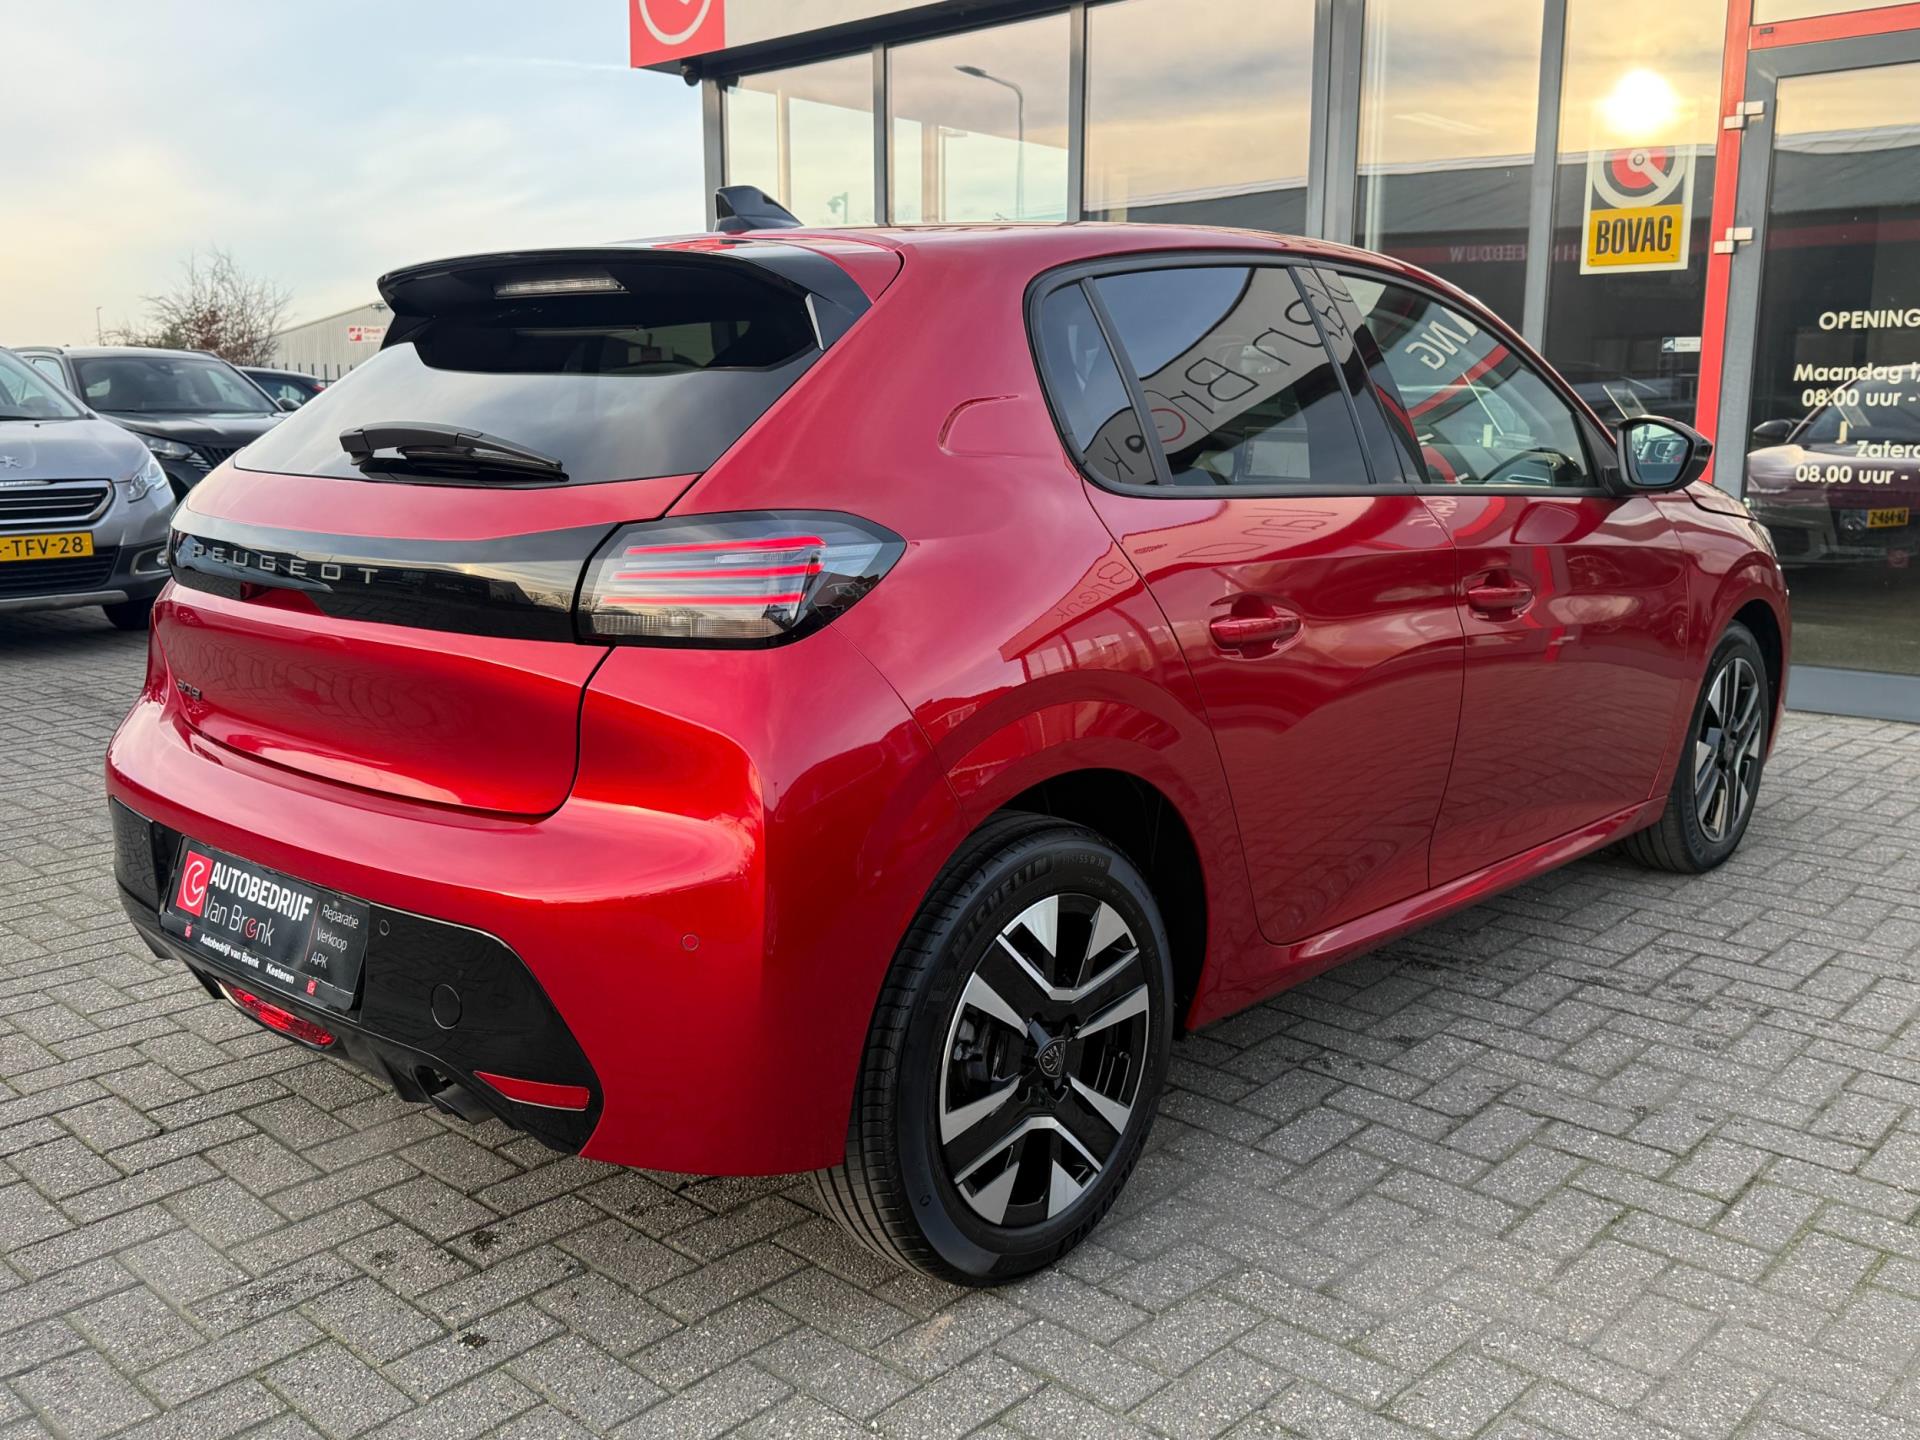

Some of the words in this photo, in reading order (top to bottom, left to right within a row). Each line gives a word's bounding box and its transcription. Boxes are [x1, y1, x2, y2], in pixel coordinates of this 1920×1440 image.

[1595, 215, 1673, 255] BOVAG
[1818, 308, 1920, 330] OPENING
[1793, 362, 1904, 385] Maandag
[1801, 388, 1860, 407] 08.00
[1865, 391, 1902, 407] uur
[1795, 465, 1852, 483] 08.00
[1858, 469, 1894, 484] uur
[193, 543, 379, 584] PEUGEOT
[209, 862, 313, 921] AUTOBEDRIJF
[204, 892, 228, 927] Van
[321, 903, 359, 929] Reparatie
[316, 927, 348, 953] Verkoop
[200, 933, 231, 957] Autobedrijf
[230, 946, 242, 960] van
[241, 952, 260, 969] Brenk
[265, 963, 295, 984] Kesteren
[310, 951, 328, 969] APK
